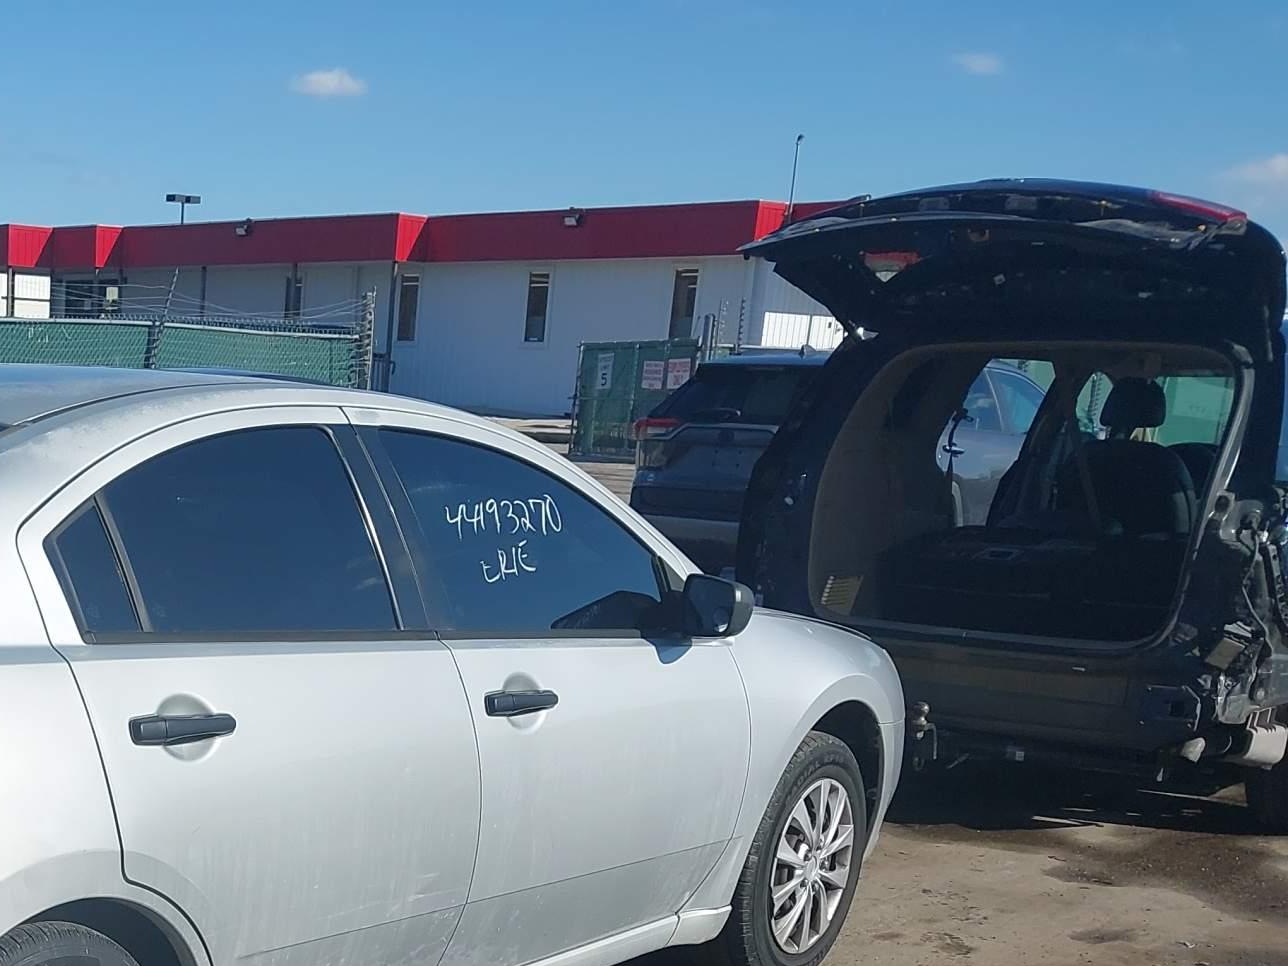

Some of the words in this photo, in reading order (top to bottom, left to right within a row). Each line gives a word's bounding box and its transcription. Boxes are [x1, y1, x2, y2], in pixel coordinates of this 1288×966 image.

[600, 372, 608, 387] 5
[444, 493, 562, 542] 44193270
[479, 539, 537, 583] ERIE
